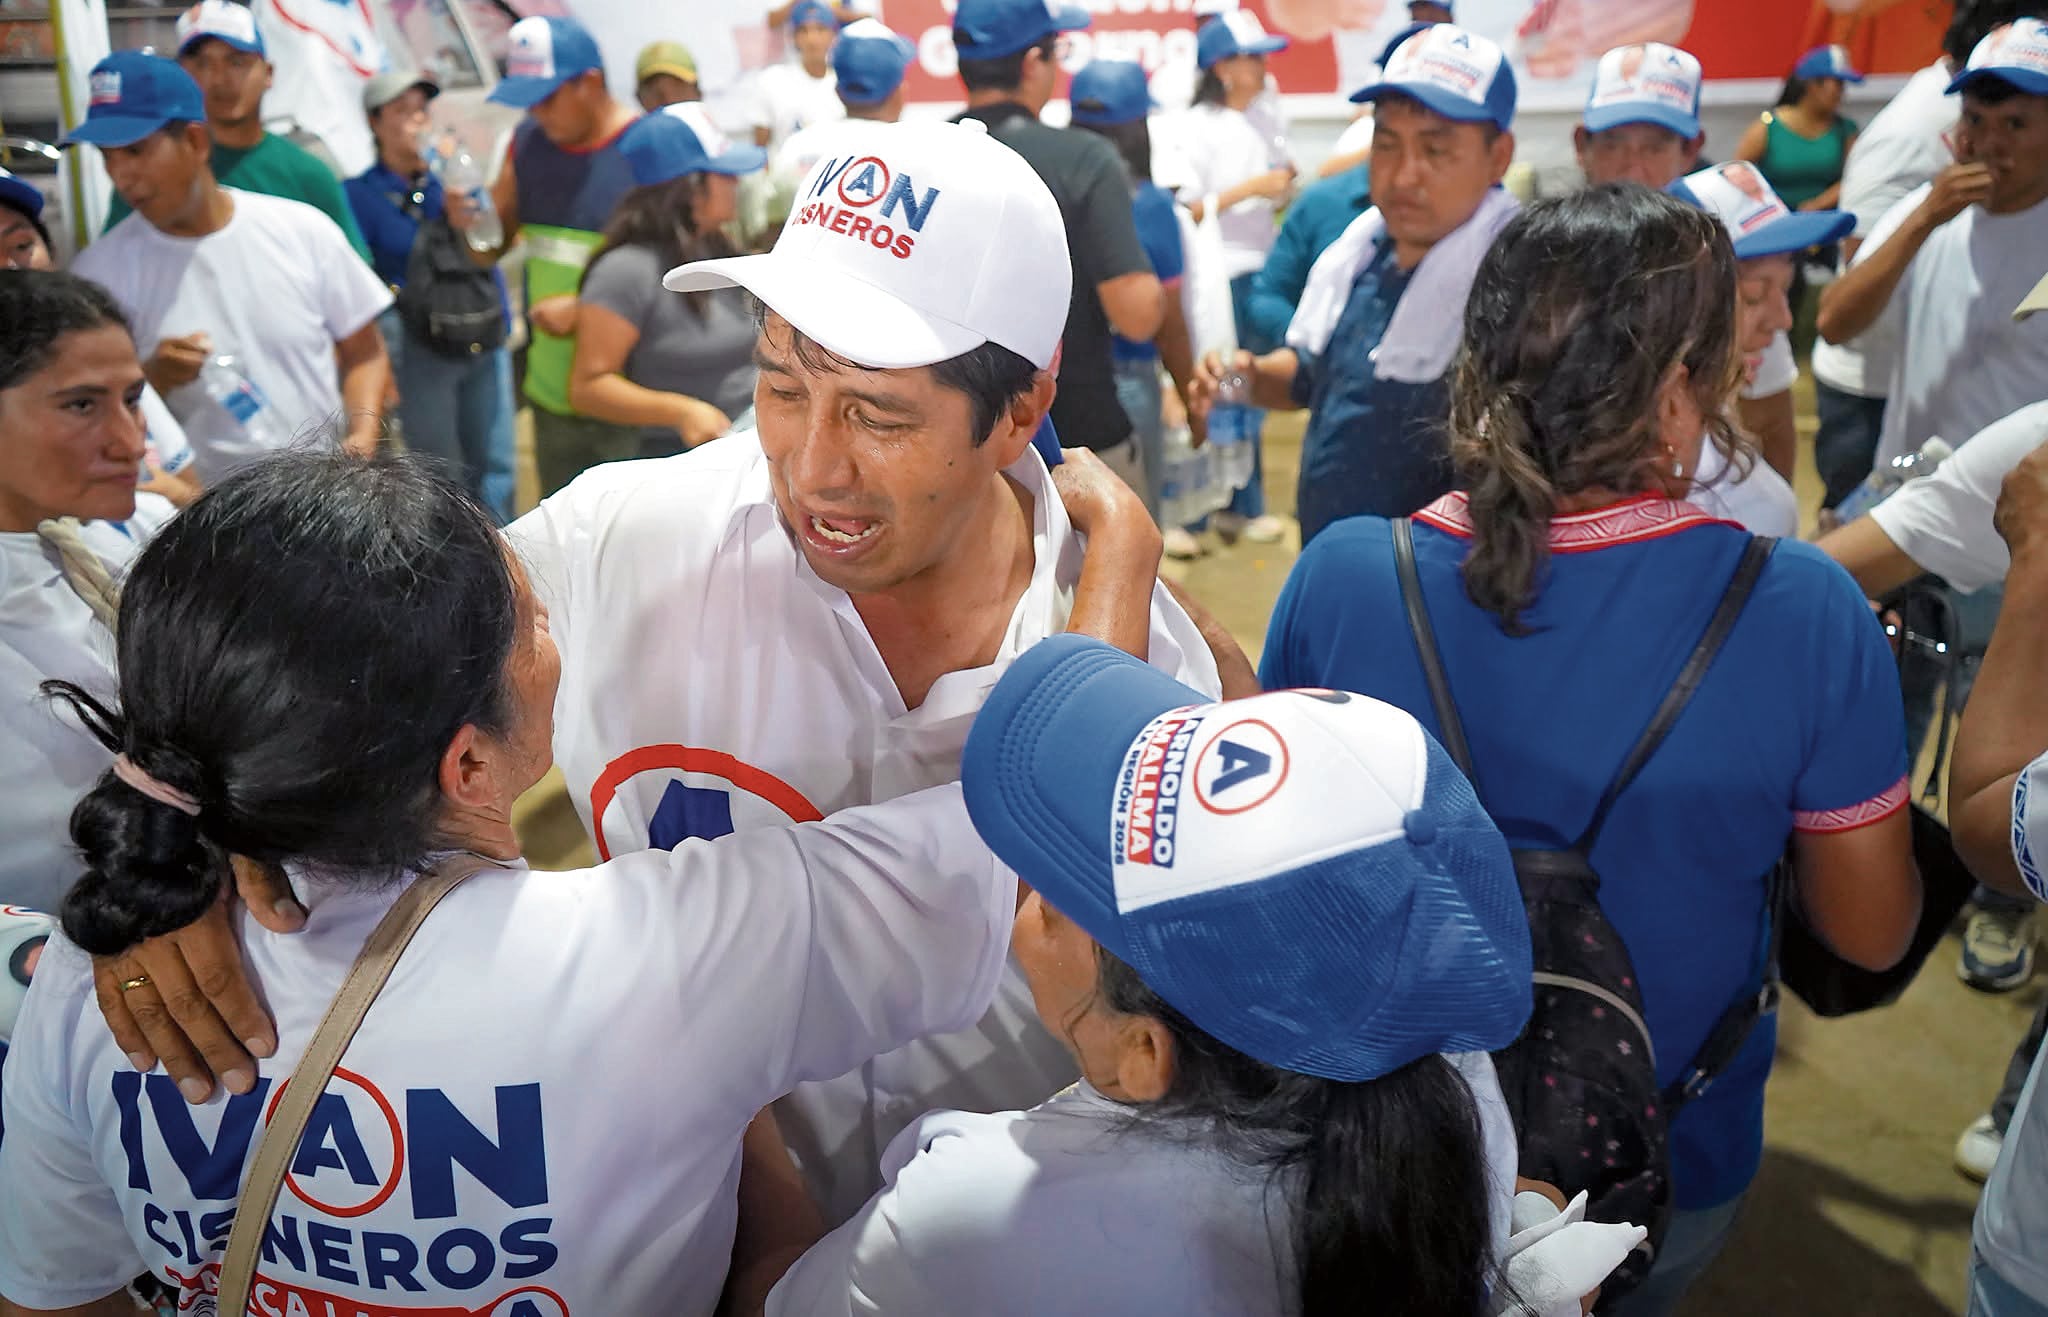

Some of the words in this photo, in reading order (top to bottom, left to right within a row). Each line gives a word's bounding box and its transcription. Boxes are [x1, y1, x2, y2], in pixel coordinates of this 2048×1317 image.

[792, 201, 915, 259] ISNEROS
[807, 155, 941, 233] IVAN
[1117, 749, 1141, 813] REGIÓN
[1130, 721, 1181, 856] MALLMA
[1152, 717, 1203, 865] ARNOLDO
[1209, 728, 1272, 797] A
[112, 1066, 549, 1220] IVAN
[144, 1202, 558, 1292] CISNEROS
